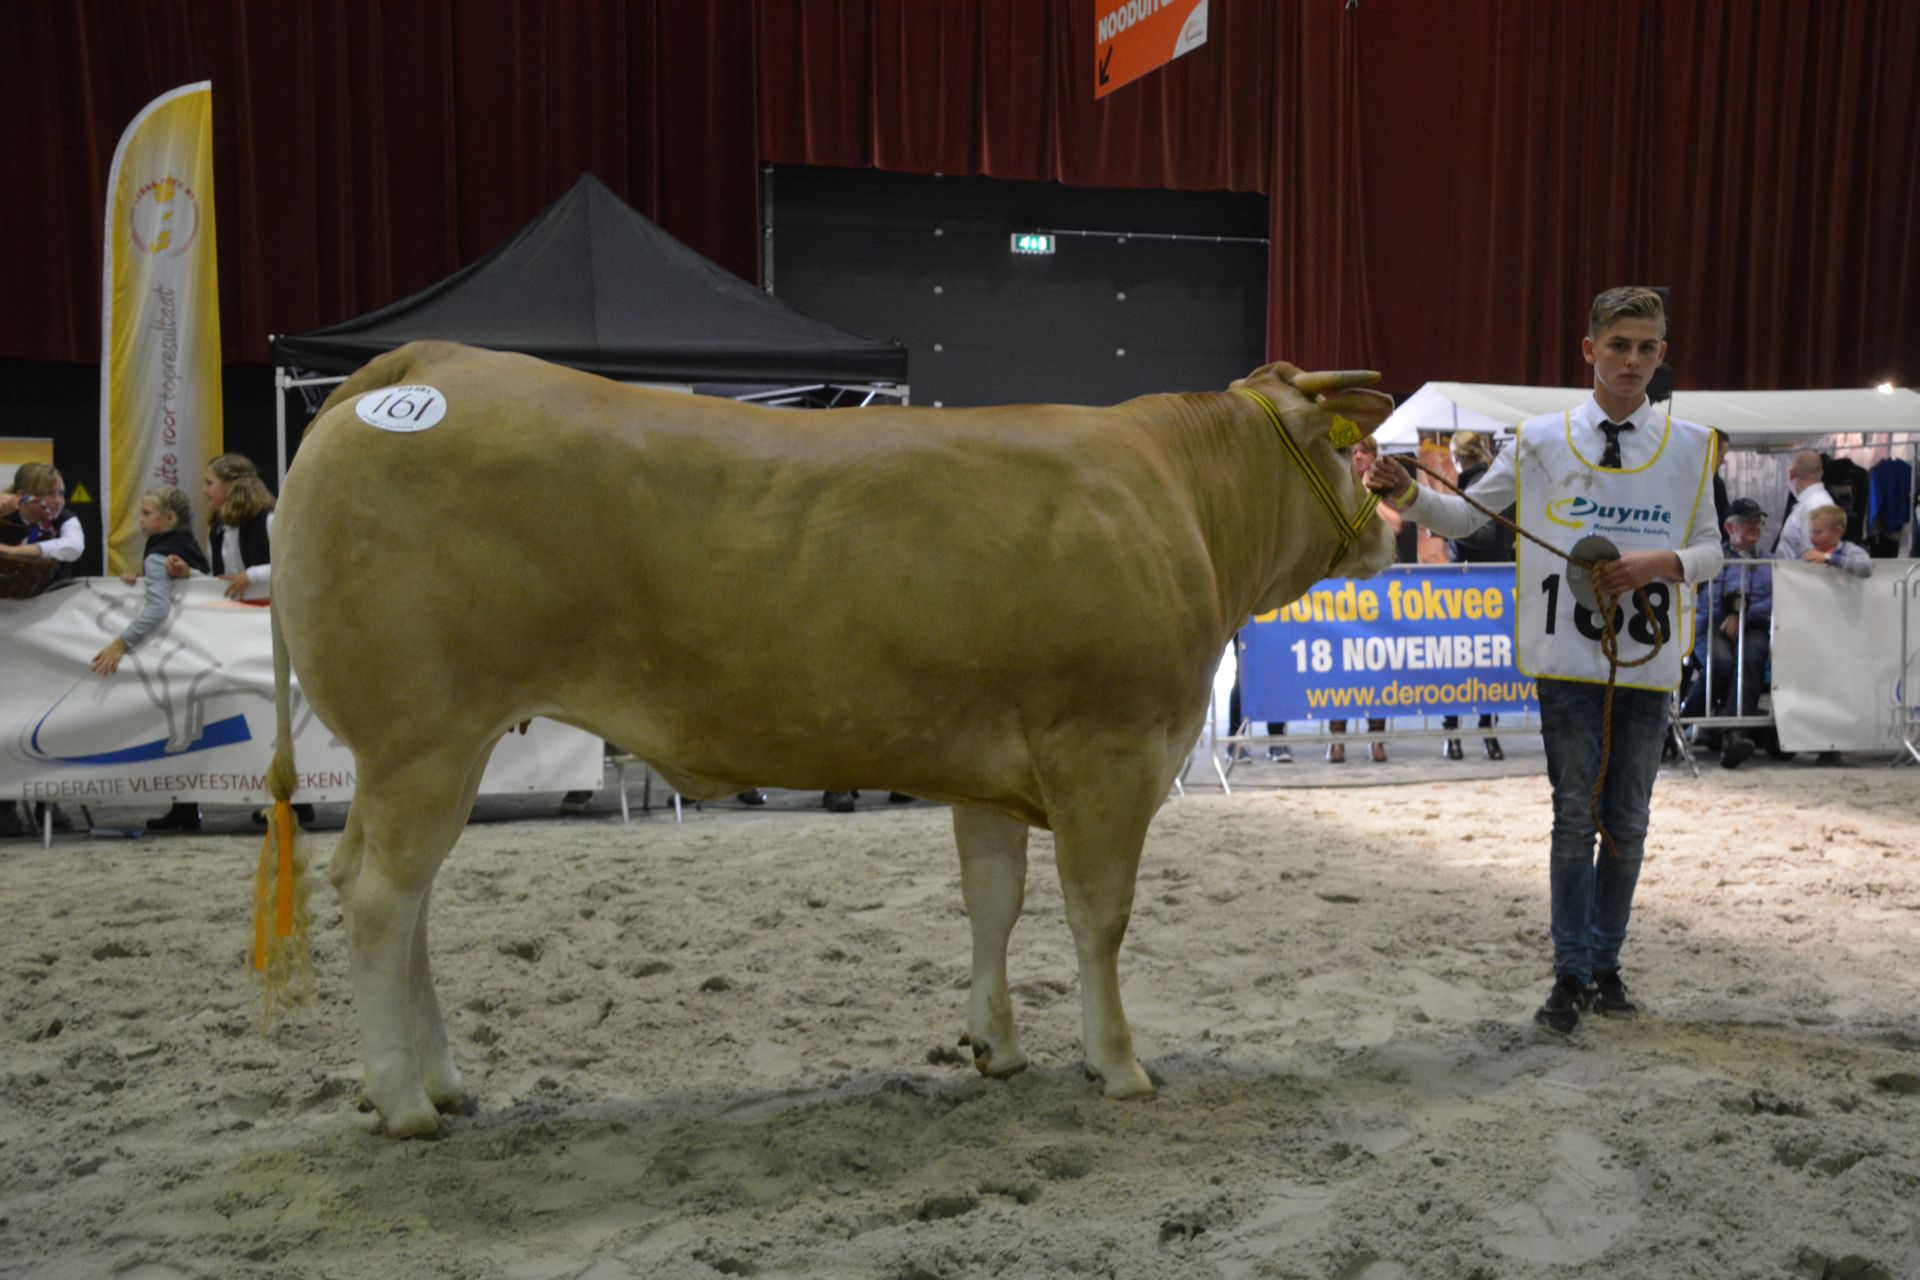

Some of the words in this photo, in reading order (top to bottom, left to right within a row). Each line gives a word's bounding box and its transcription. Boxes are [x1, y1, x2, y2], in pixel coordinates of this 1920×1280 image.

[1098, 0, 1175, 45] NOODUIT
[150, 284, 184, 401] topresultaat
[372, 393, 435, 422] 161
[1570, 496, 1672, 524] Duynie
[1388, 580, 1503, 619] fokvee
[1291, 638, 1333, 673] 18
[1342, 634, 1512, 671] NOVEMBER
[22, 779, 125, 798] FEDERATIE
[128, 770, 342, 793] VLEESVEESTAMEKEN
